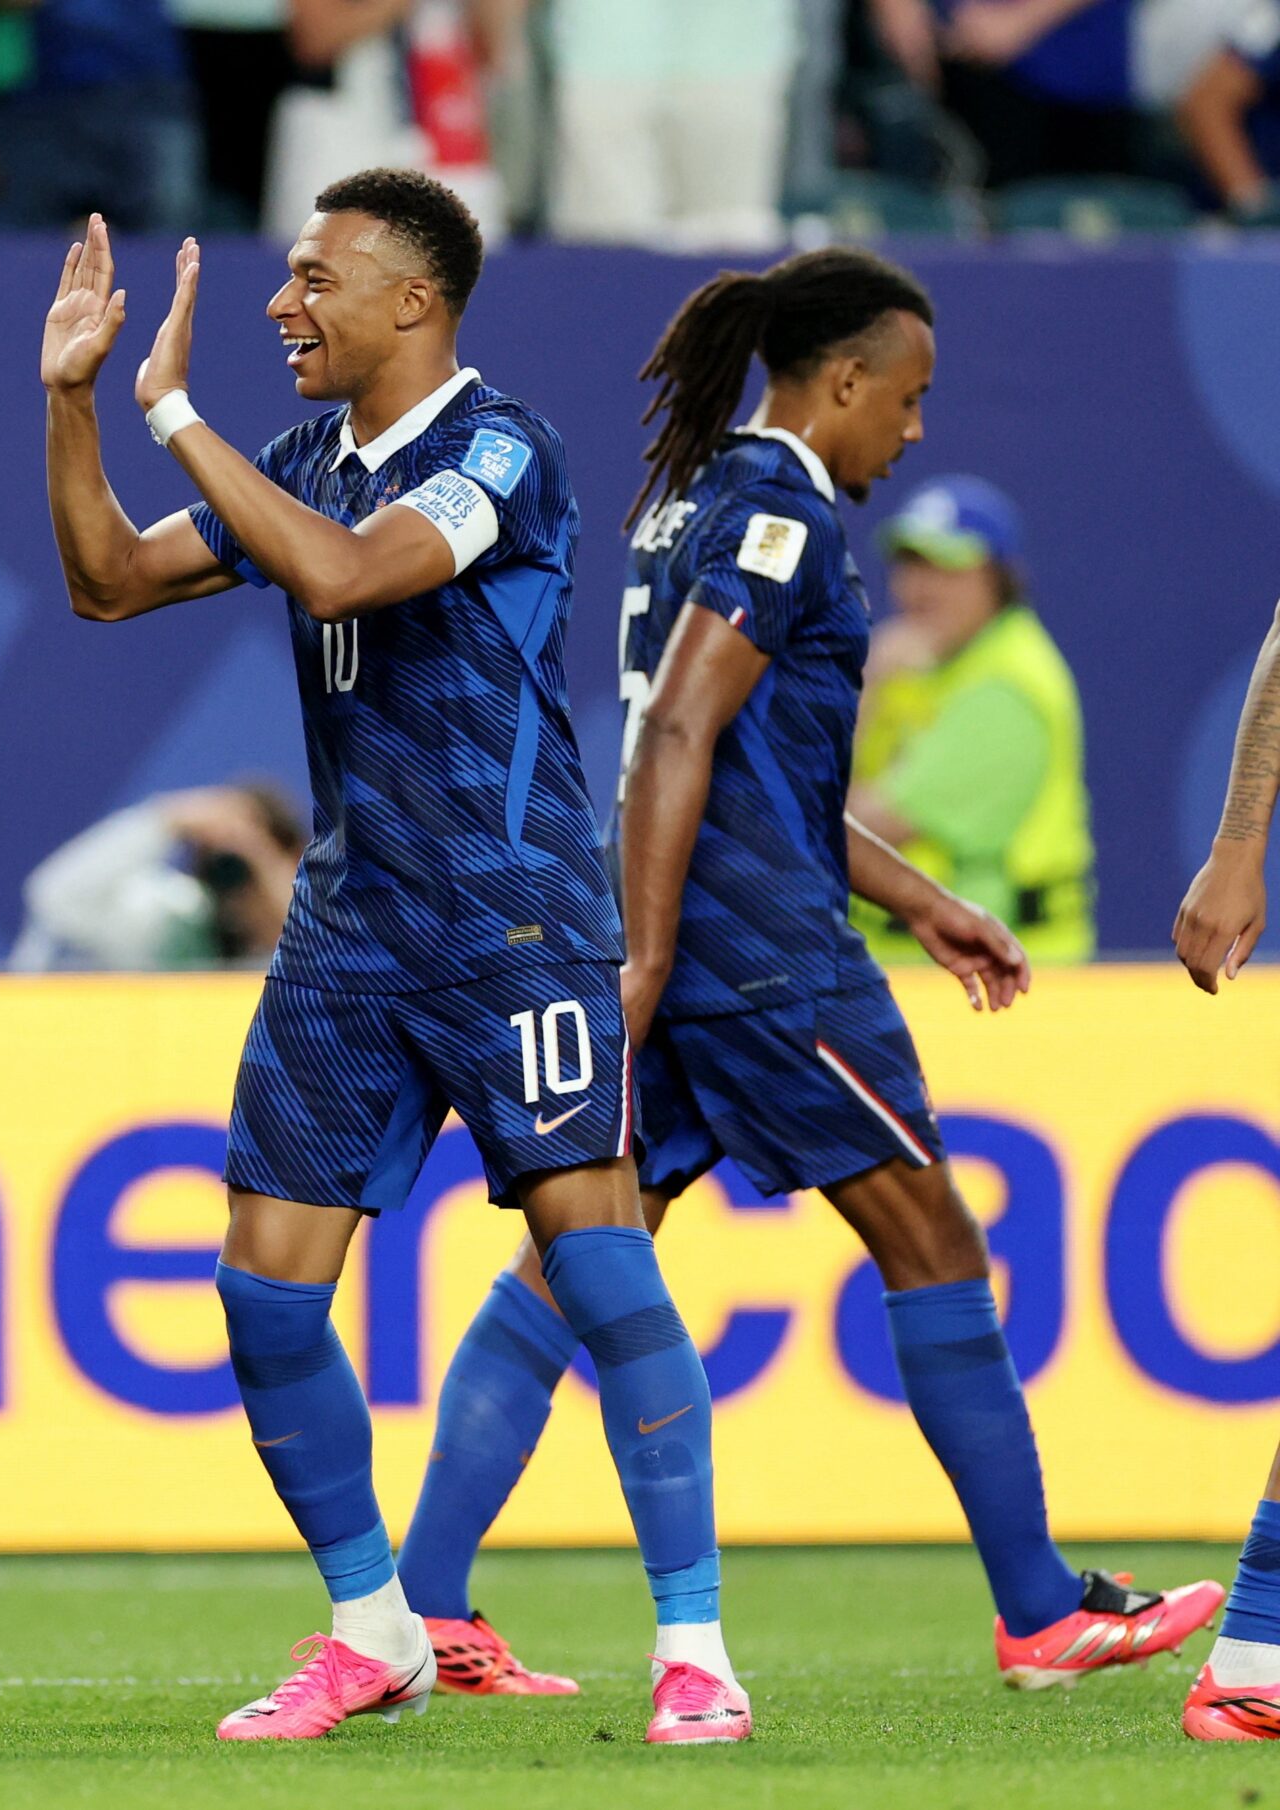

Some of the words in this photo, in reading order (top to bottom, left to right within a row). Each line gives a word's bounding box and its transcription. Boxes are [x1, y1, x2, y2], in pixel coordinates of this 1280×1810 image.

[480, 458, 508, 478] PEACE
[423, 482, 473, 519] UNITES
[436, 472, 481, 509] FOOTBALL
[429, 498, 464, 530] World
[323, 618, 359, 694] 10
[510, 1000, 593, 1104] 10
